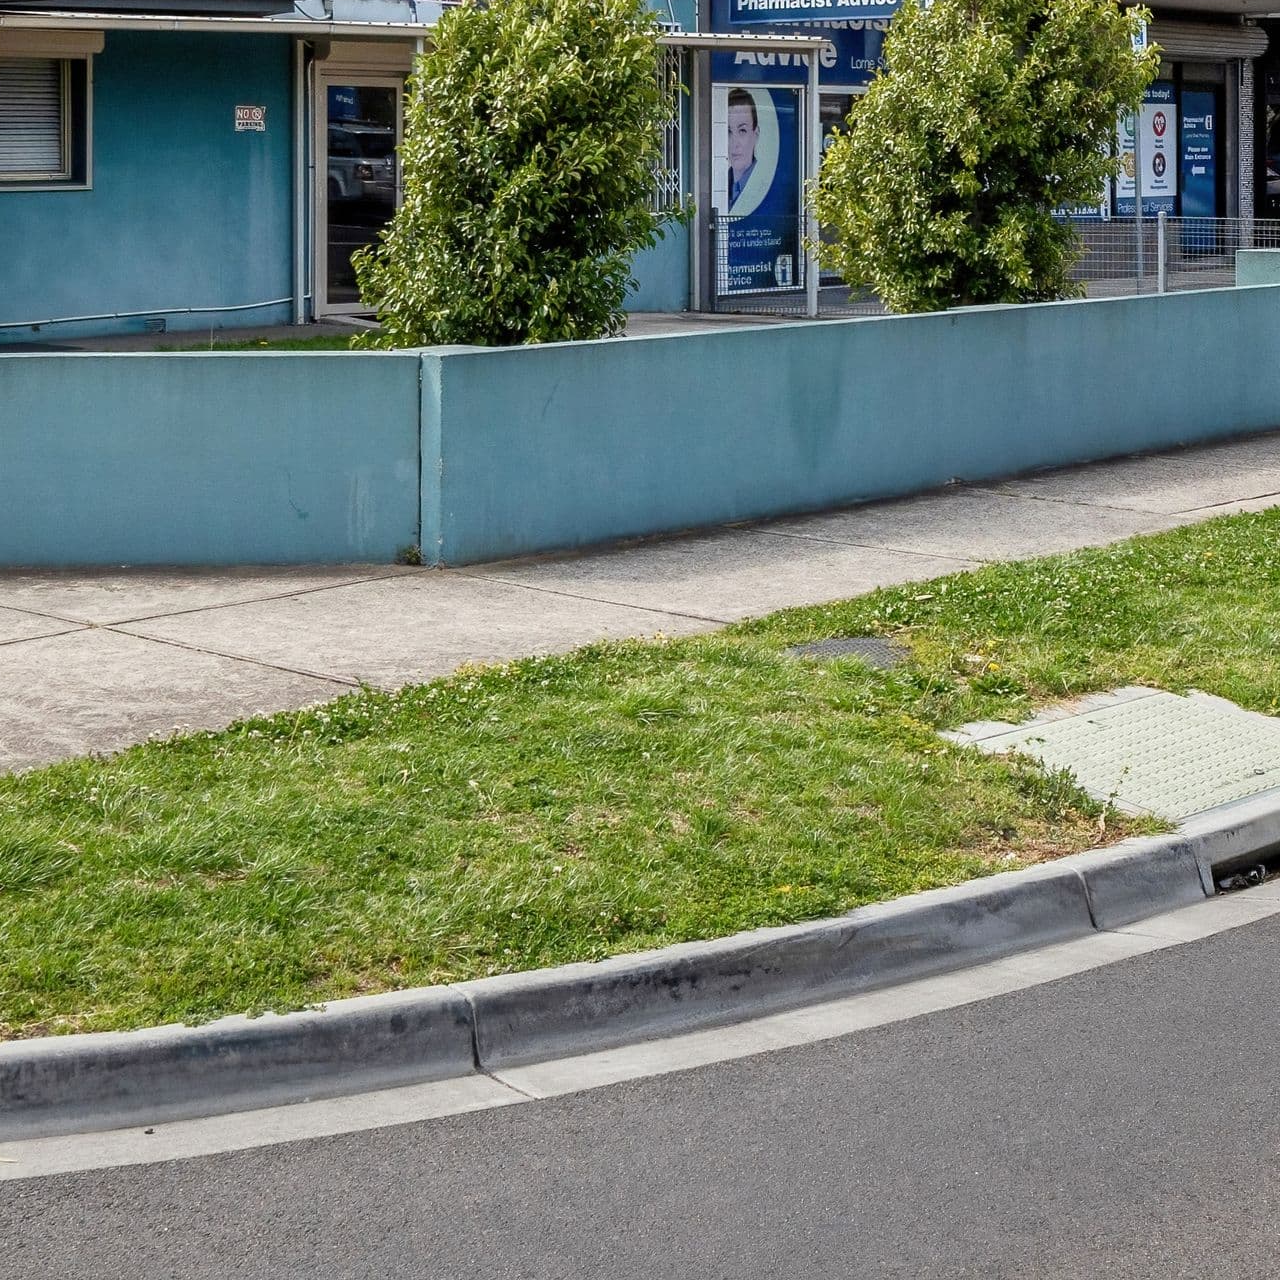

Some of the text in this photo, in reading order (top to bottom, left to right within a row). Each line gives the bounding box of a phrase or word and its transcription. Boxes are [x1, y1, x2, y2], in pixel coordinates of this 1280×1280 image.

[851, 56, 876, 69] Lorne
[1151, 89, 1171, 100] today!
[237, 108, 249, 119] NO
